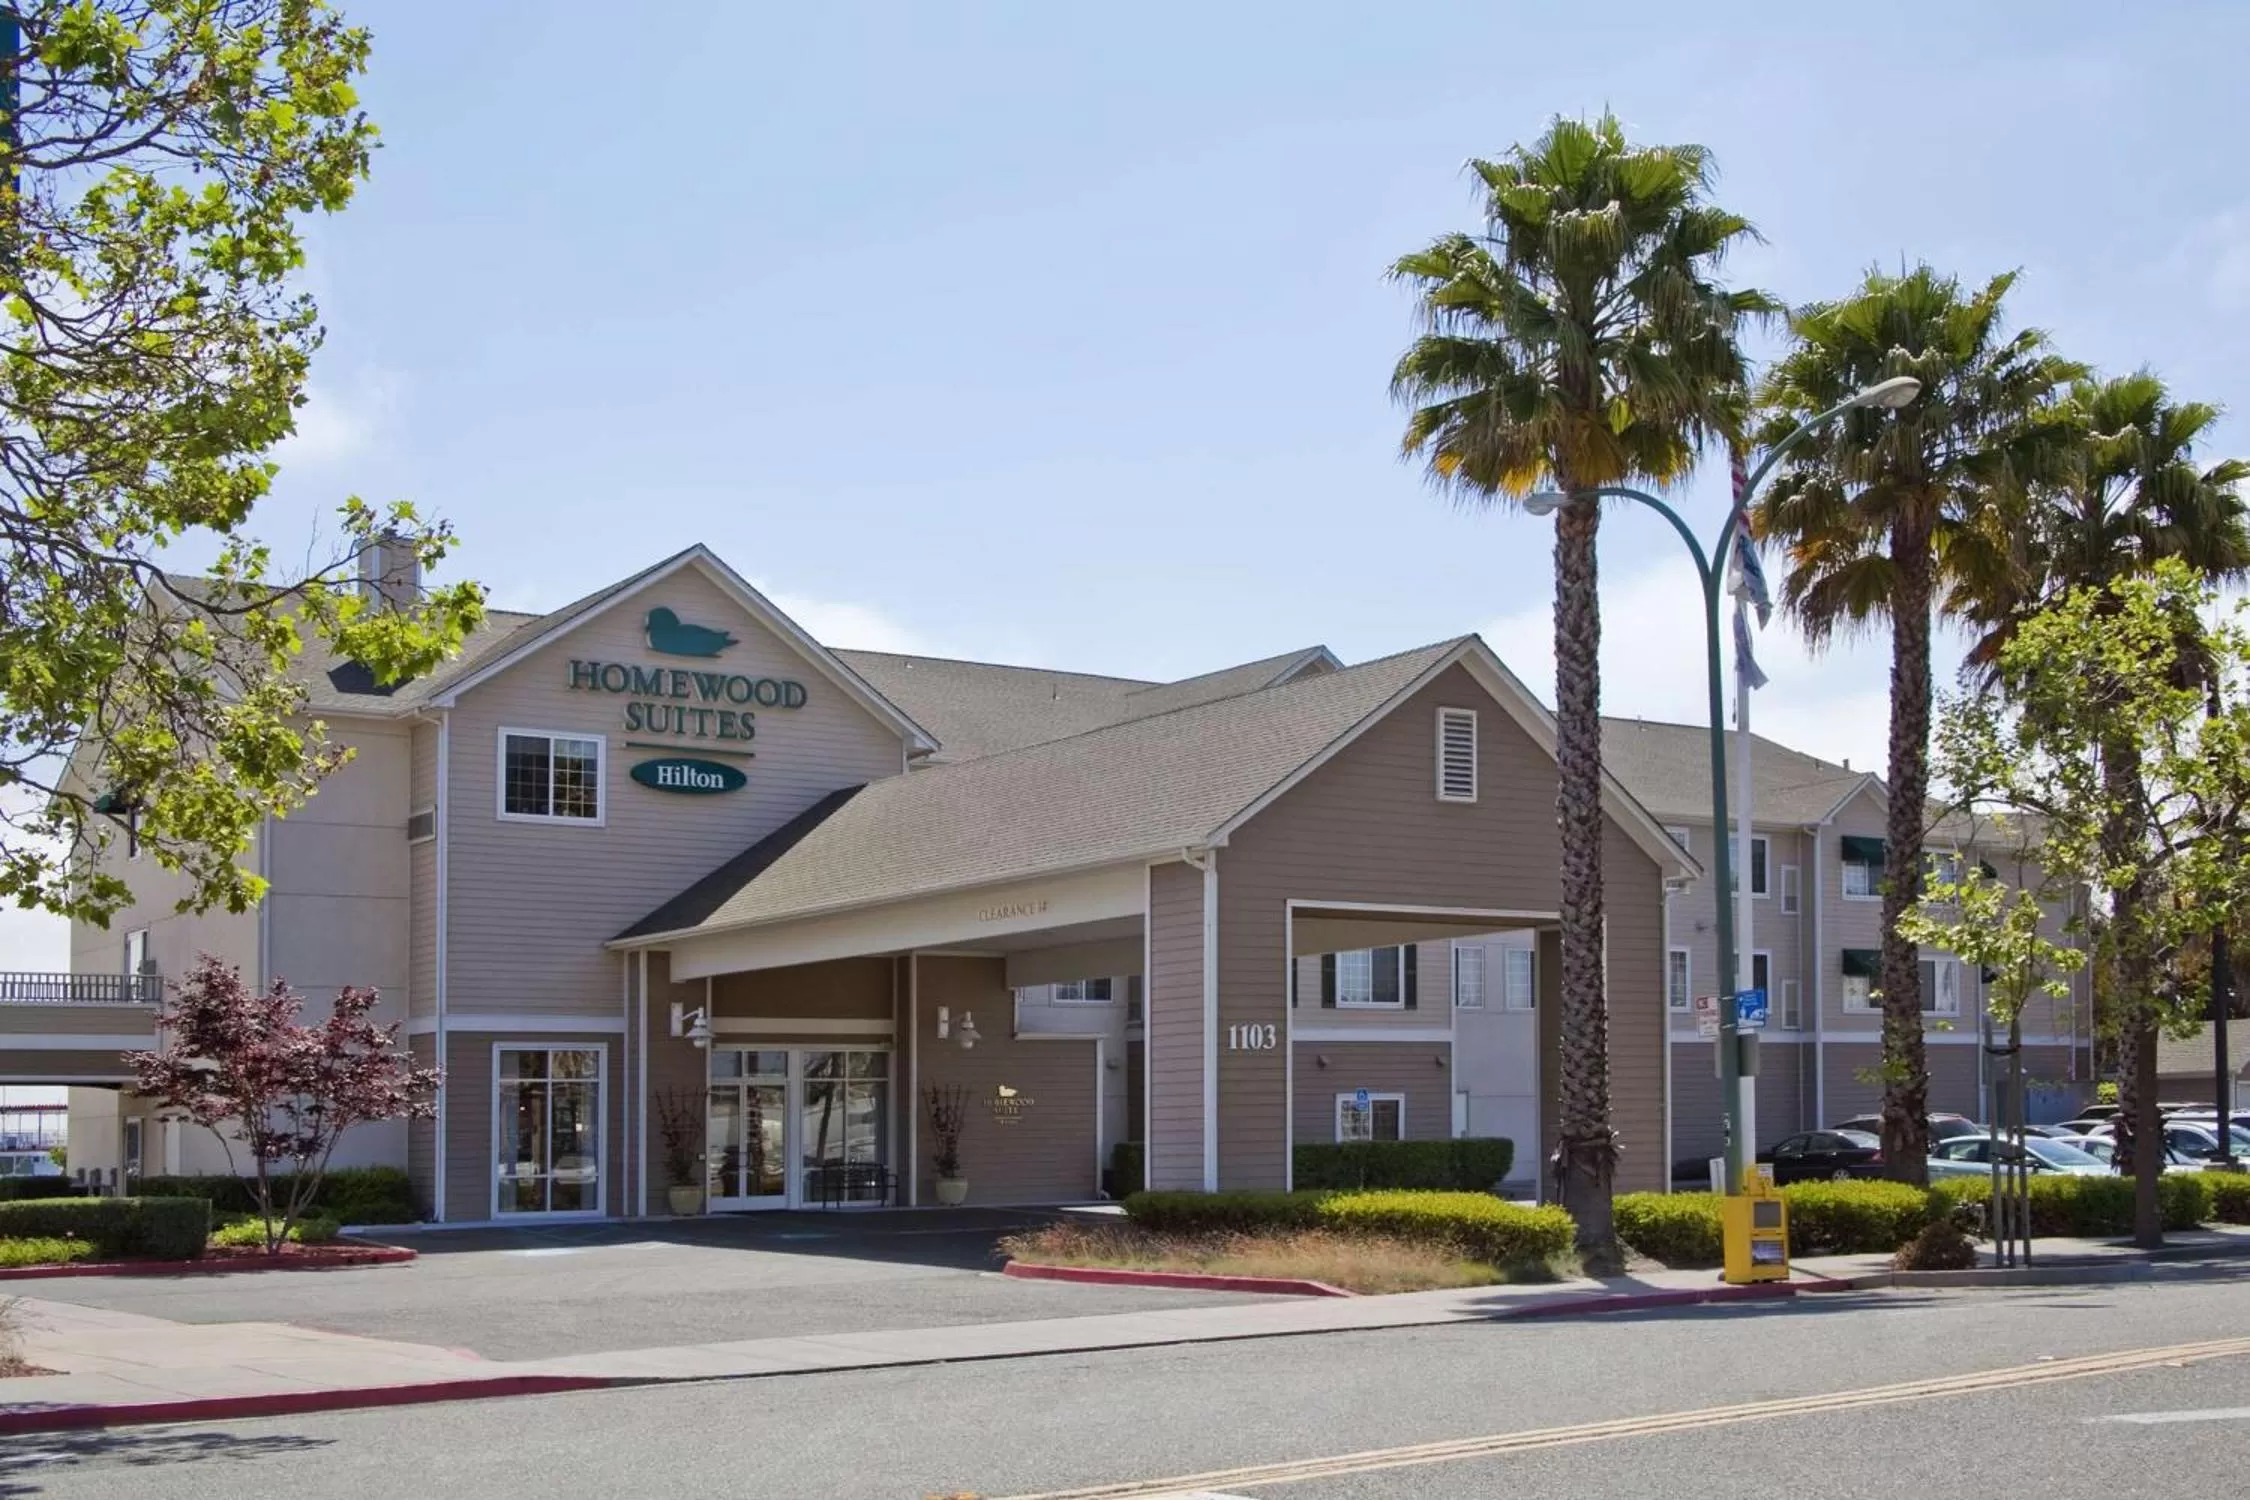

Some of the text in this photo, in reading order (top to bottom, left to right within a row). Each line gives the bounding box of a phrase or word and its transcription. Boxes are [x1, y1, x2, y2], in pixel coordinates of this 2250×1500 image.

[569, 660, 808, 710] HOMEWOOD
[624, 702, 756, 741] SUITES
[656, 764, 724, 789] Hilton
[1229, 1023, 1277, 1050] 1103
